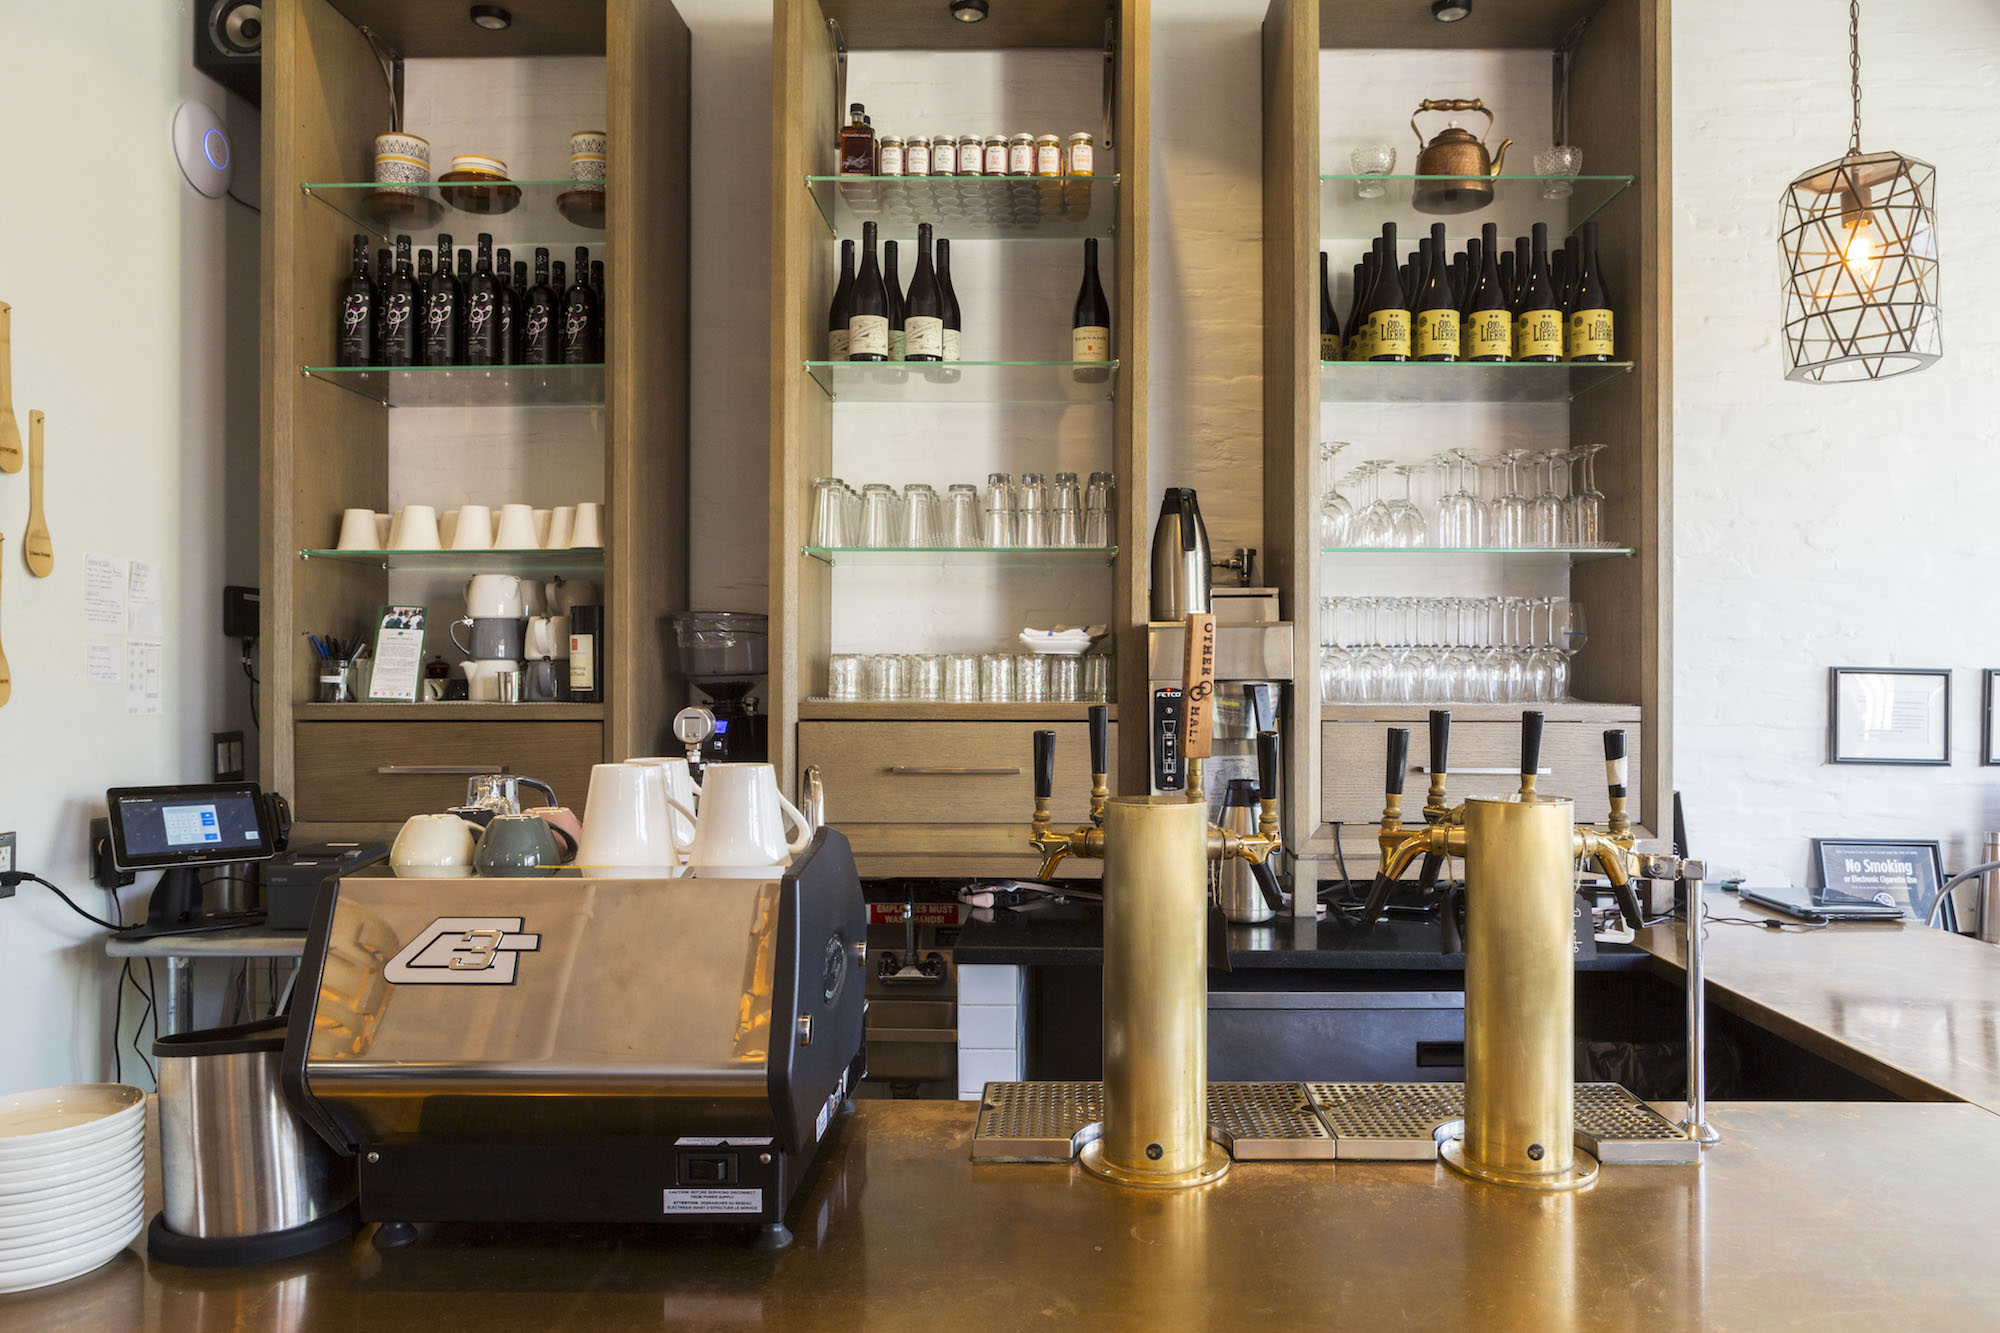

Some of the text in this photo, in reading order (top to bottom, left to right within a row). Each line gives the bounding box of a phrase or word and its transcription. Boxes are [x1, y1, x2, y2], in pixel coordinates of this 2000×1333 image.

[1388, 320, 1400, 329] OJO
[1439, 320, 1451, 329] OJO
[1488, 321, 1500, 329] OJO
[1540, 321, 1552, 329] OJO
[1596, 320, 1608, 328] OJO
[1381, 324, 1406, 341] LIEBRE
[1432, 324, 1457, 341] LIEBRE
[1480, 324, 1506, 342] LIEBRE
[1533, 324, 1559, 342] LIEBRE
[1588, 324, 1612, 342] LIEBRE
[1202, 622, 1213, 676] OTHER
[1845, 859, 1913, 875] No Smoking
[929, 905, 953, 914] MUST
[885, 915, 908, 924] WAS
